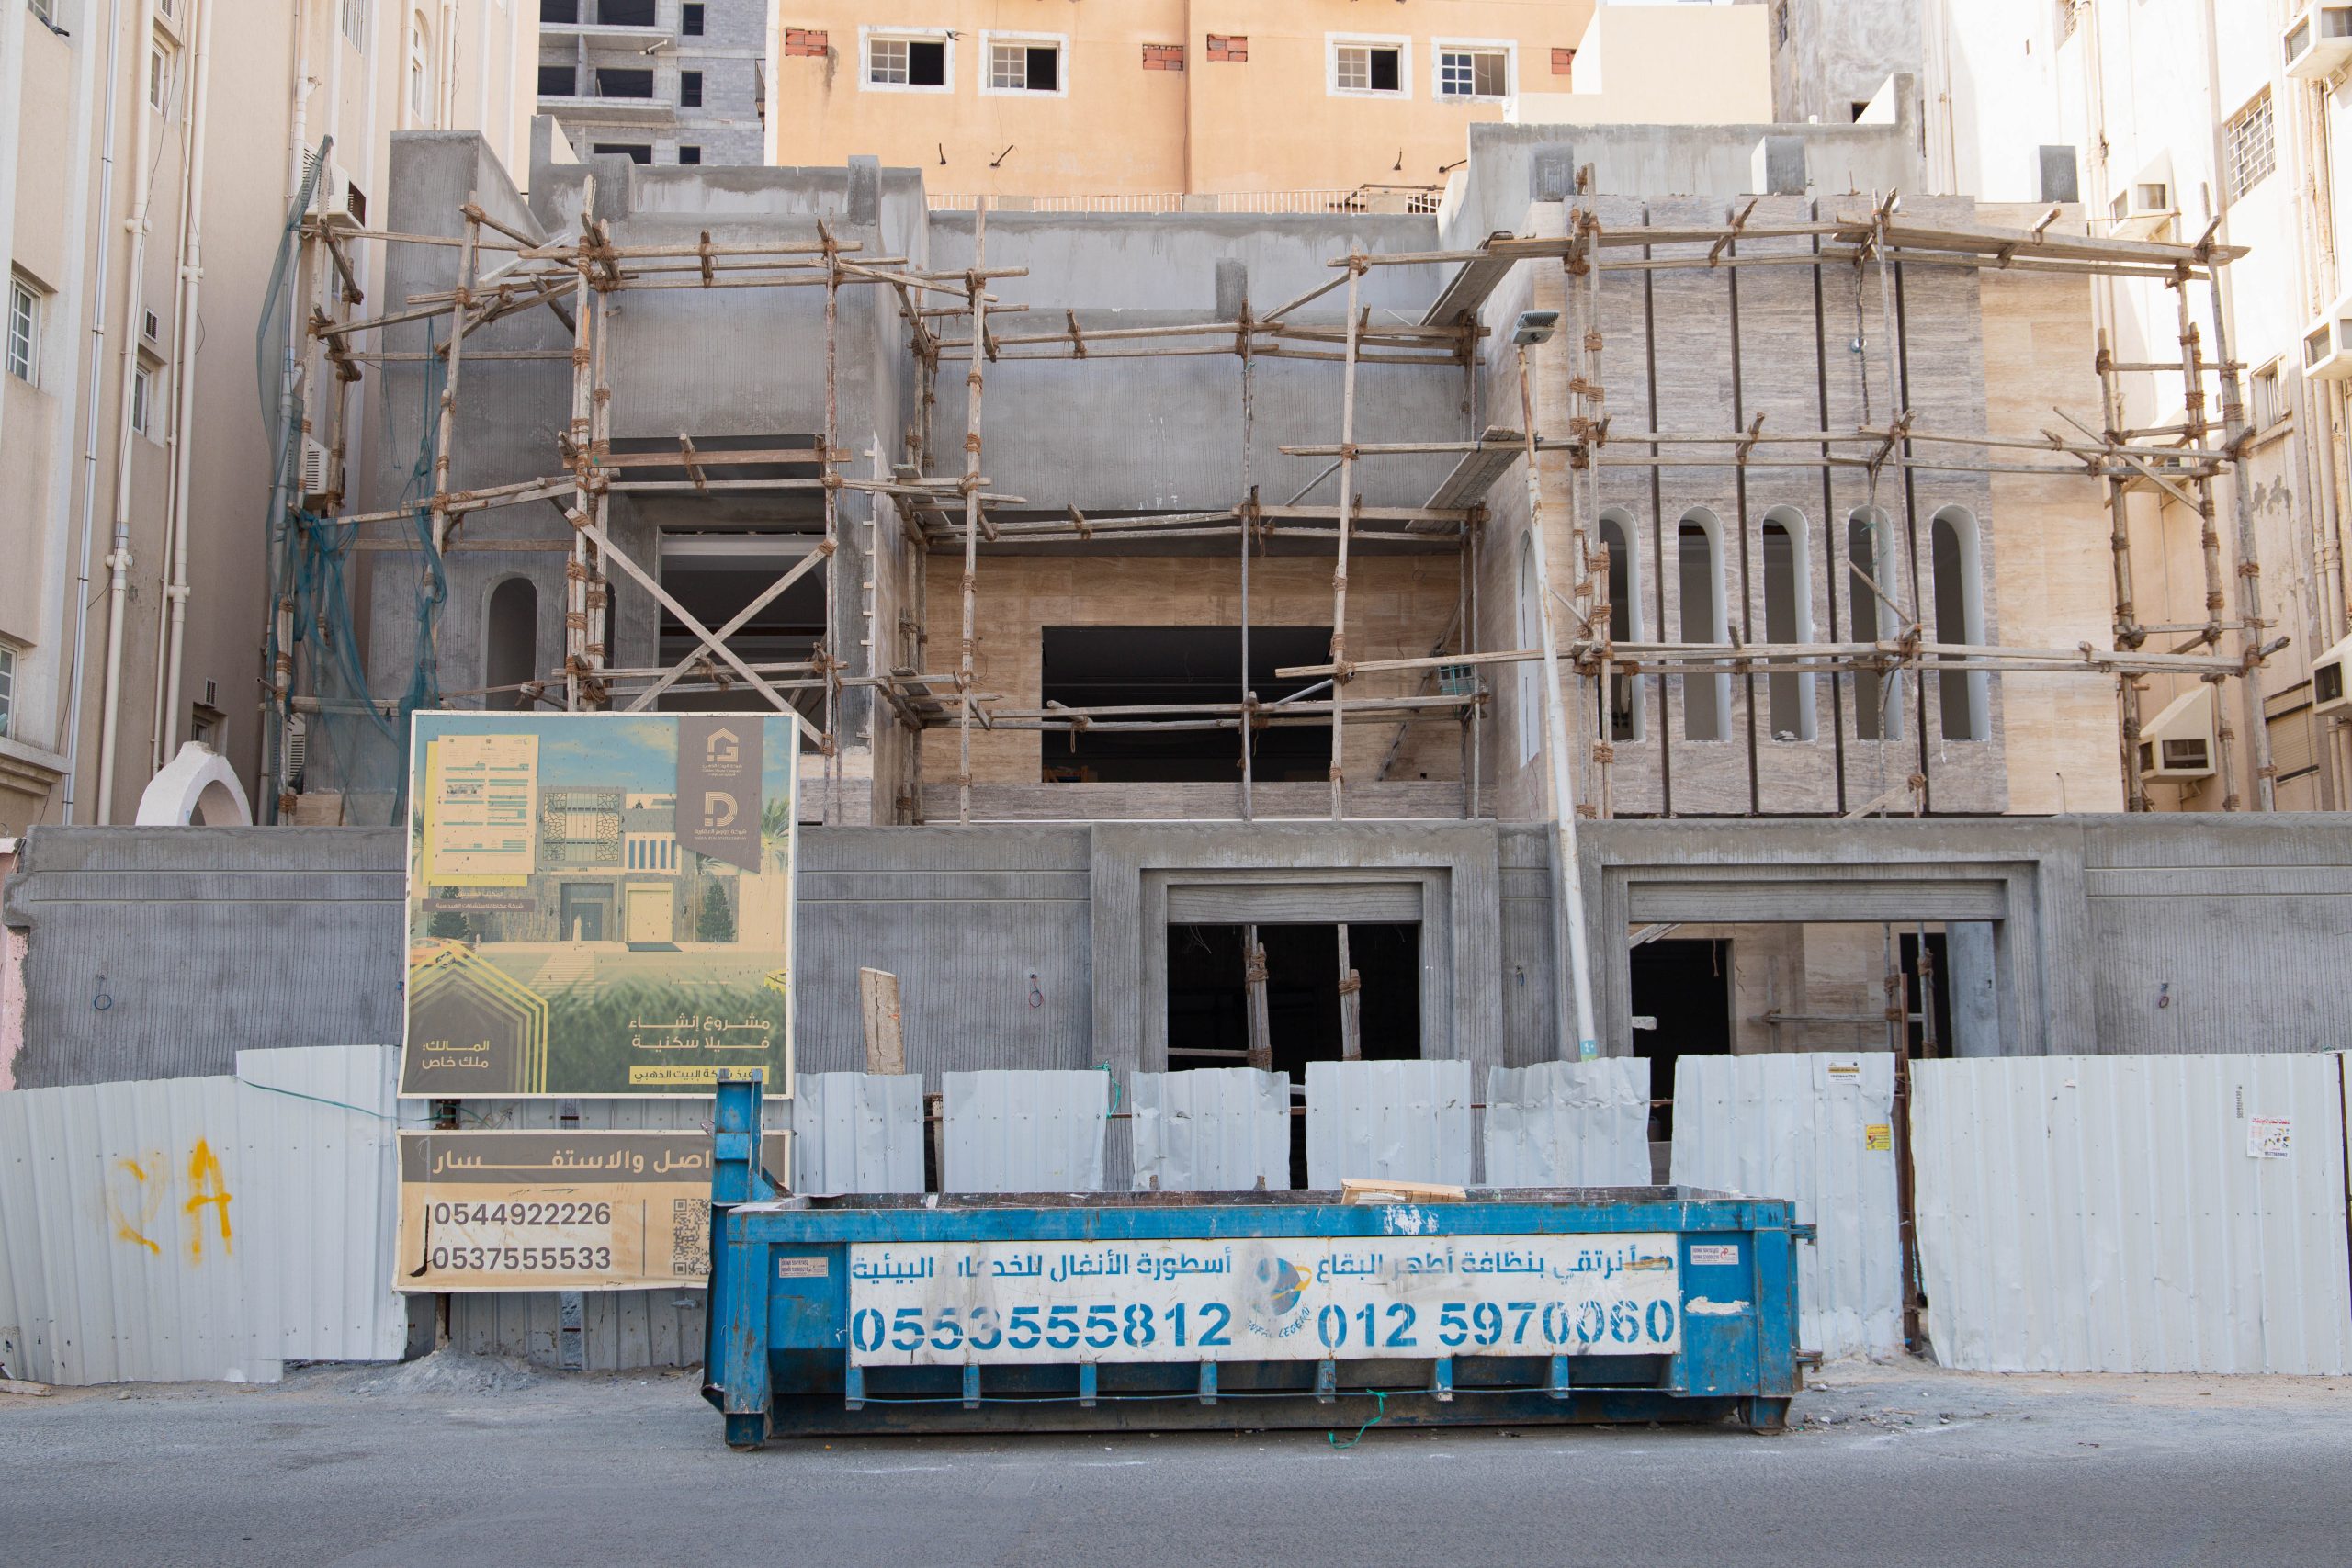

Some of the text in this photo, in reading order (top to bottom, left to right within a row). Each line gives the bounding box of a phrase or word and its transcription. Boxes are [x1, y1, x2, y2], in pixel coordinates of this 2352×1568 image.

[628, 1013, 770, 1032] مشروع إنشاء
[631, 1034, 770, 1053] فيلا سكنية
[422, 1056, 489, 1070] ملك خاص
[634, 1068, 671, 1082] الذهبي
[673, 1069, 701, 1081] البيت
[432, 1149, 645, 1175] والاستفسار
[434, 1201, 611, 1227] 0544922226
[432, 1246, 611, 1271] 0537555533
[852, 1251, 934, 1285] البيئية
[1050, 1249, 1130, 1282] الأنفال
[1136, 1247, 1232, 1282] أسطورة
[1316, 1252, 1384, 1285] البقاع
[1462, 1251, 1545, 1279] بنظافة
[851, 1301, 1232, 1353] 0553555812
[1317, 1298, 1676, 1349] 012 5970060
